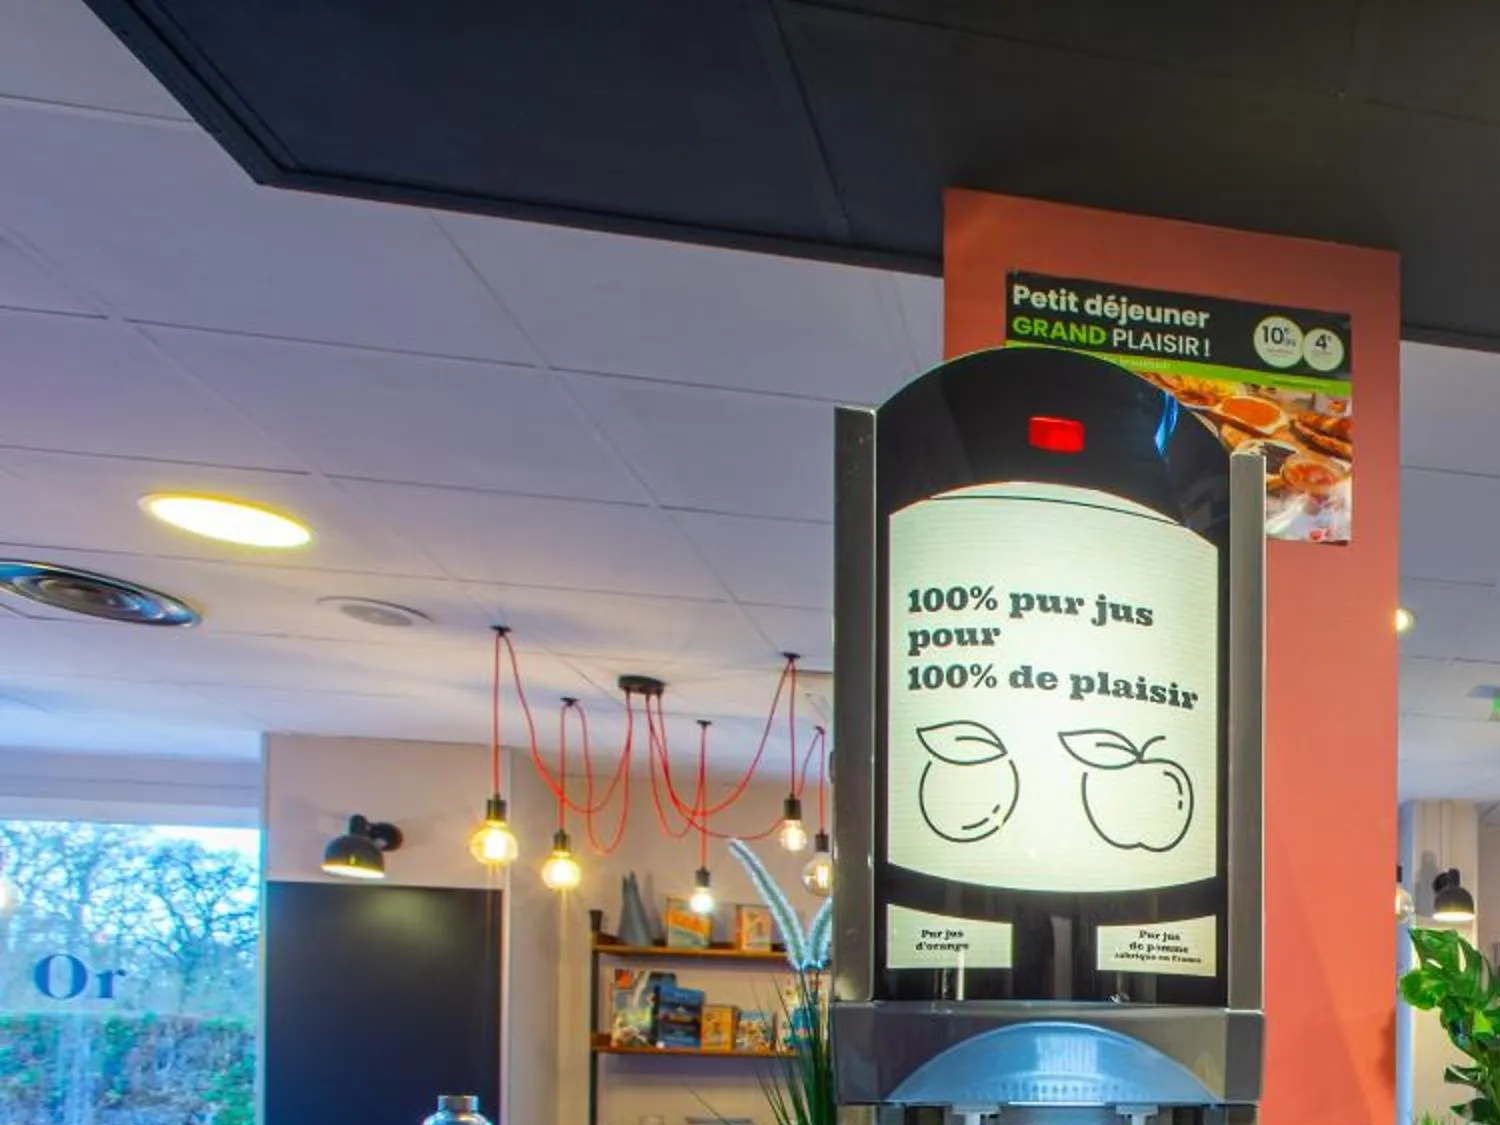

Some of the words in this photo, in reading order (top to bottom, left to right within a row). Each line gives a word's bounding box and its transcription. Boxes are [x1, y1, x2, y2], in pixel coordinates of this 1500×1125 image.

[1013, 284, 1079, 313] Petit
[1084, 293, 1210, 328] déjeuner
[1012, 316, 1106, 345] GRAND
[1112, 328, 1199, 356] PLAISIR
[908, 586, 998, 613] 100%
[1009, 592, 1085, 618] pur
[1091, 594, 1154, 627] jus
[908, 627, 1001, 656] pour
[908, 664, 998, 691] 100%
[1009, 666, 1059, 691] de
[1069, 672, 1199, 710] plaisir
[921, 929, 942, 938] Pur
[33, 953, 125, 1000] Or
